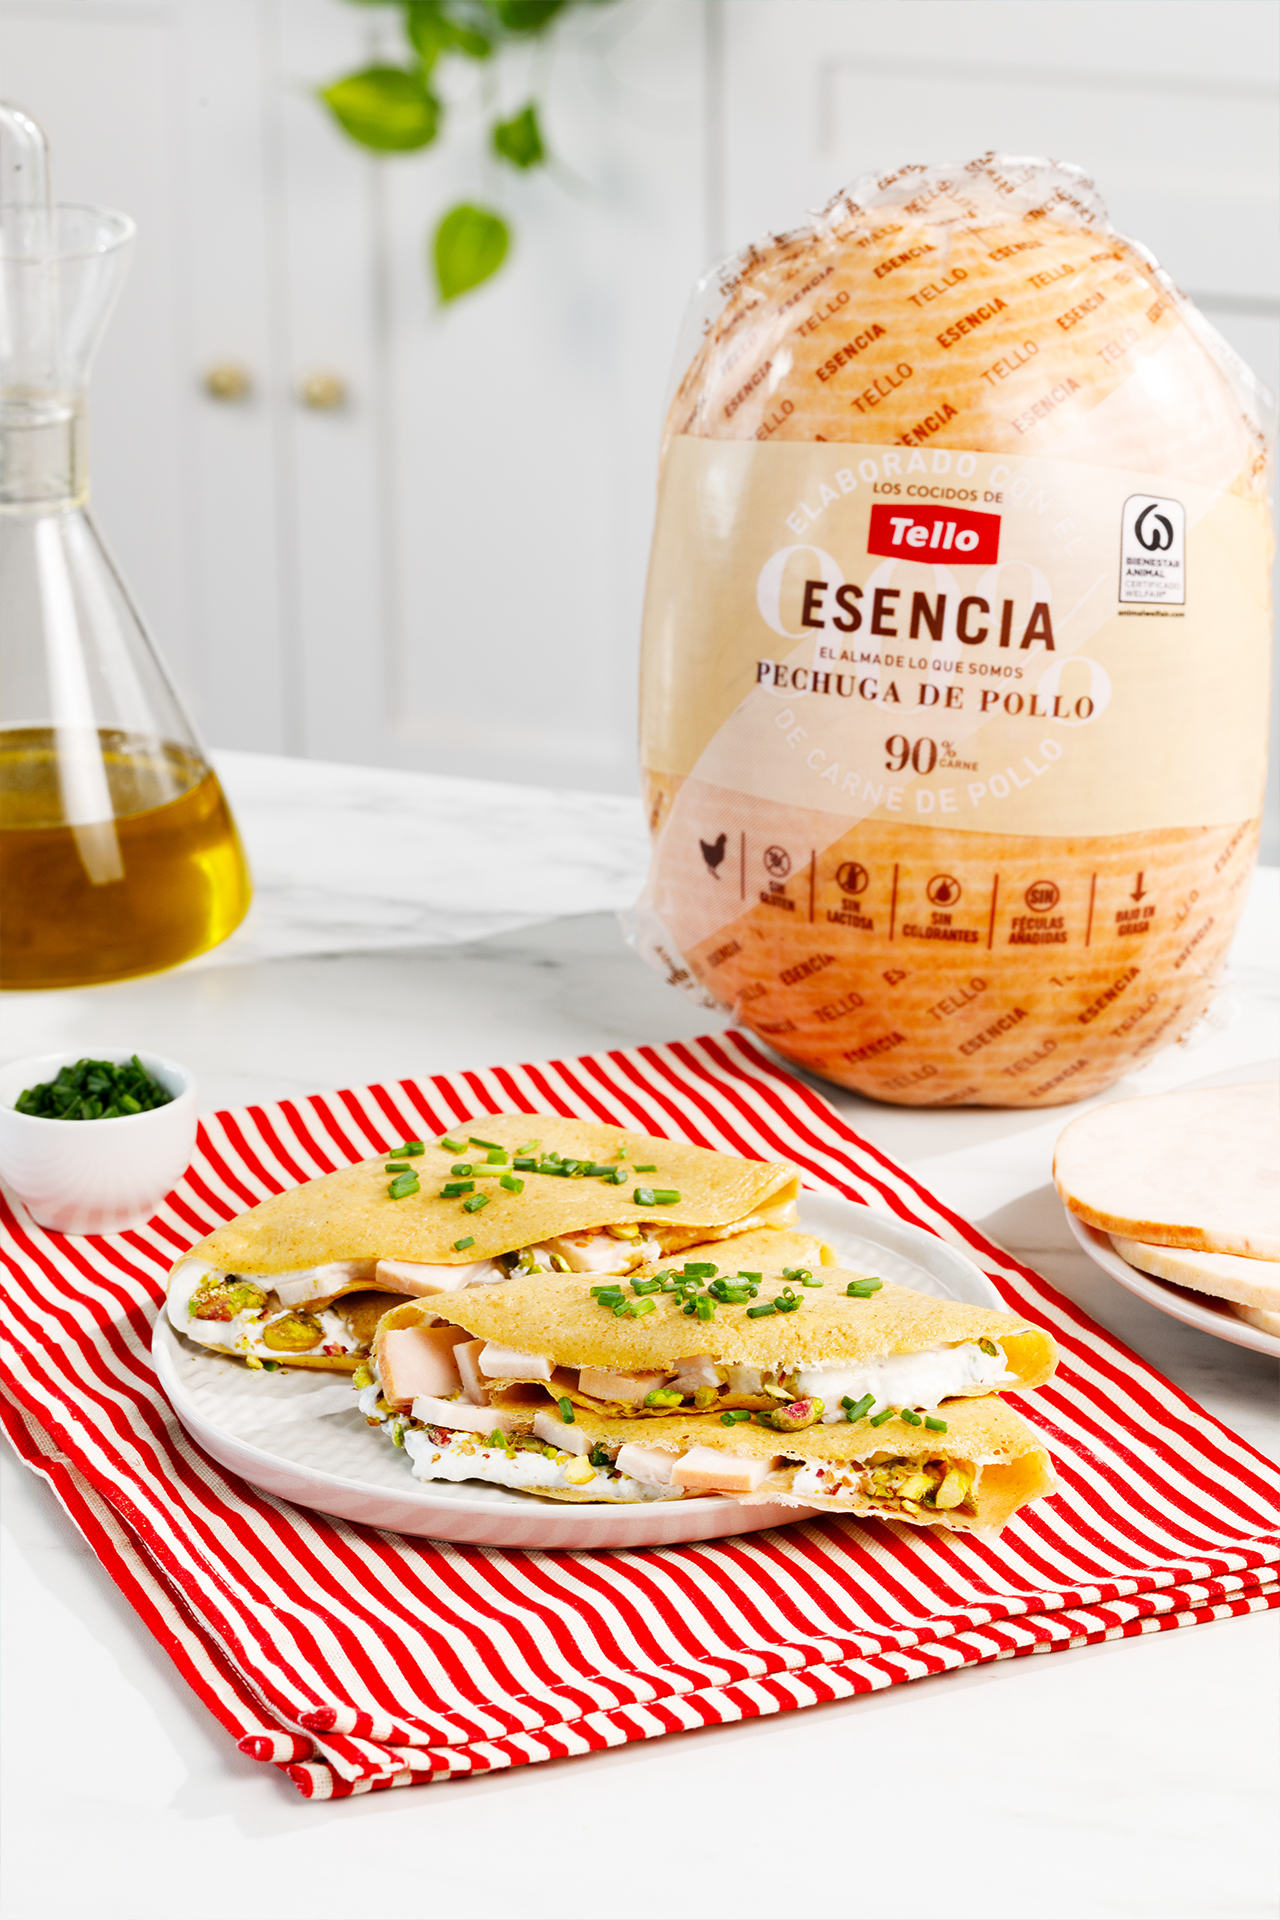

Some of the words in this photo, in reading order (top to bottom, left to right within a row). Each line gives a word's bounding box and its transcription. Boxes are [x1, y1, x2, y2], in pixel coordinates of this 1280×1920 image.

[873, 244, 938, 280] ESENCIA
[1026, 262, 1076, 291] TELLO
[906, 266, 969, 309] TELLO
[794, 290, 851, 339] TELLO
[935, 296, 1010, 350] ESENCIA
[1055, 291, 1108, 332] ESENCIA
[814, 323, 888, 384] ESENCIA
[978, 338, 1041, 387] TELLO
[723, 360, 774, 419] ESENCIA
[850, 361, 915, 415] TELLO
[1010, 376, 1083, 435] ESENCIA
[754, 399, 796, 442] ELLO
[894, 402, 960, 448] ENCIA
[785, 448, 978, 536] ELABORADO
[988, 464, 1053, 517] CON
[1052, 516, 1084, 559] EL
[872, 481, 902, 496] LOS
[906, 483, 978, 502] COCIDOS
[983, 490, 1004, 504] DE
[889, 516, 981, 552] Tello
[1125, 568, 1166, 579] ANIMAL
[801, 579, 1056, 652] ESENCIA
[819, 646, 836, 660] EL
[839, 649, 882, 666] ALMA
[884, 654, 905, 669] DE
[908, 657, 929, 670] LO
[931, 658, 964, 675] QUE
[968, 662, 1025, 680] SOMOS
[756, 661, 902, 704] PECHUGA
[917, 682, 964, 711] DE
[979, 688, 1095, 720] POLLO
[774, 707, 809, 750] DE
[806, 747, 906, 813] CARNE
[915, 786, 959, 815] DE
[966, 737, 1064, 809] POLLO
[938, 757, 979, 773] CARNE
[841, 897, 862, 913] SIN
[1030, 887, 1055, 904] SIN
[1115, 907, 1140, 923] BAJO
[1142, 905, 1156, 919] EN
[826, 908, 875, 931] LACTOSA
[902, 922, 979, 944] COLORANTES
[930, 910, 953, 926] SIN
[1007, 929, 1068, 946] AÑADIDAS
[1011, 913, 1065, 932] FÉCULAS
[778, 953, 837, 987] ESENCIA
[813, 991, 865, 1024] TELLO
[927, 976, 988, 1022] TELLO
[1077, 965, 1141, 1025] ESENCIA
[1109, 991, 1160, 1038] TELLO
[843, 1031, 908, 1065] ESENCIA
[958, 1006, 1029, 1057] ESENCIA
[1001, 1037, 1059, 1078] TELLO
[1027, 1057, 1091, 1099] ESENCIA
